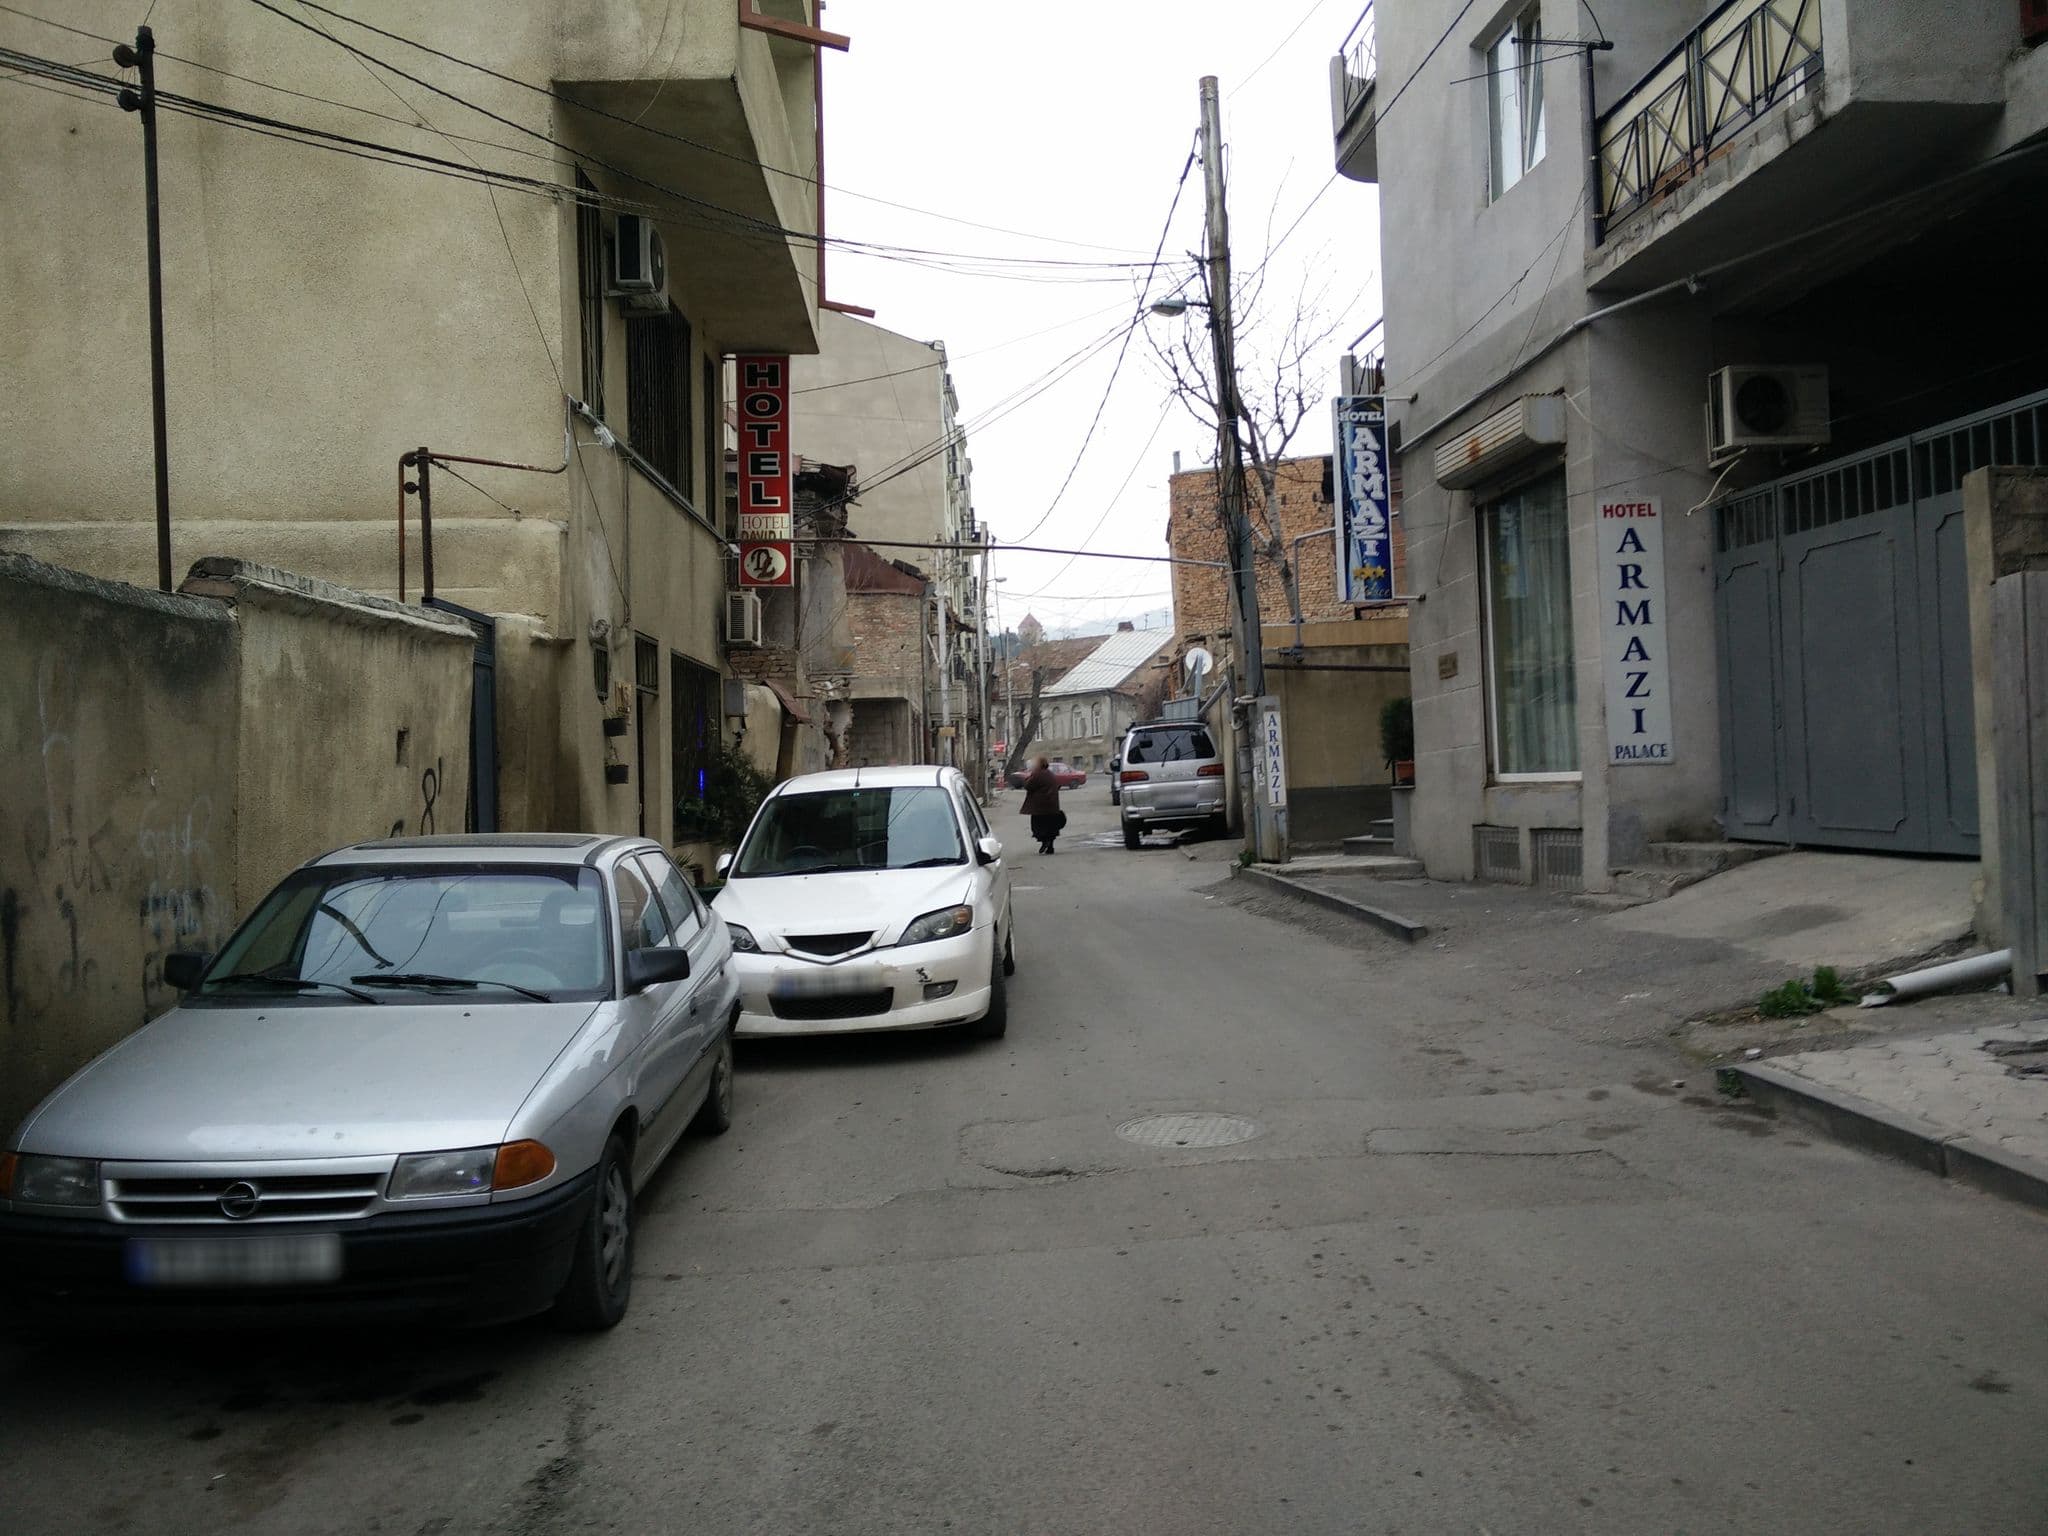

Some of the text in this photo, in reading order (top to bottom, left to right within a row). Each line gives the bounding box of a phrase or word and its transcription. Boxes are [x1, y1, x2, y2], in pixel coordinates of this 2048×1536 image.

[1339, 411, 1384, 422] HOTEL
[744, 362, 782, 507] HOTEL
[1351, 427, 1388, 557] ARMAZI
[1602, 503, 1657, 518] HOTEL
[741, 516, 788, 529] HOTEL
[741, 530, 776, 541] DAVID
[1615, 527, 1653, 734] ARMAZI
[1268, 713, 1281, 804] ARMAZI
[1614, 743, 1668, 759] PALACE
